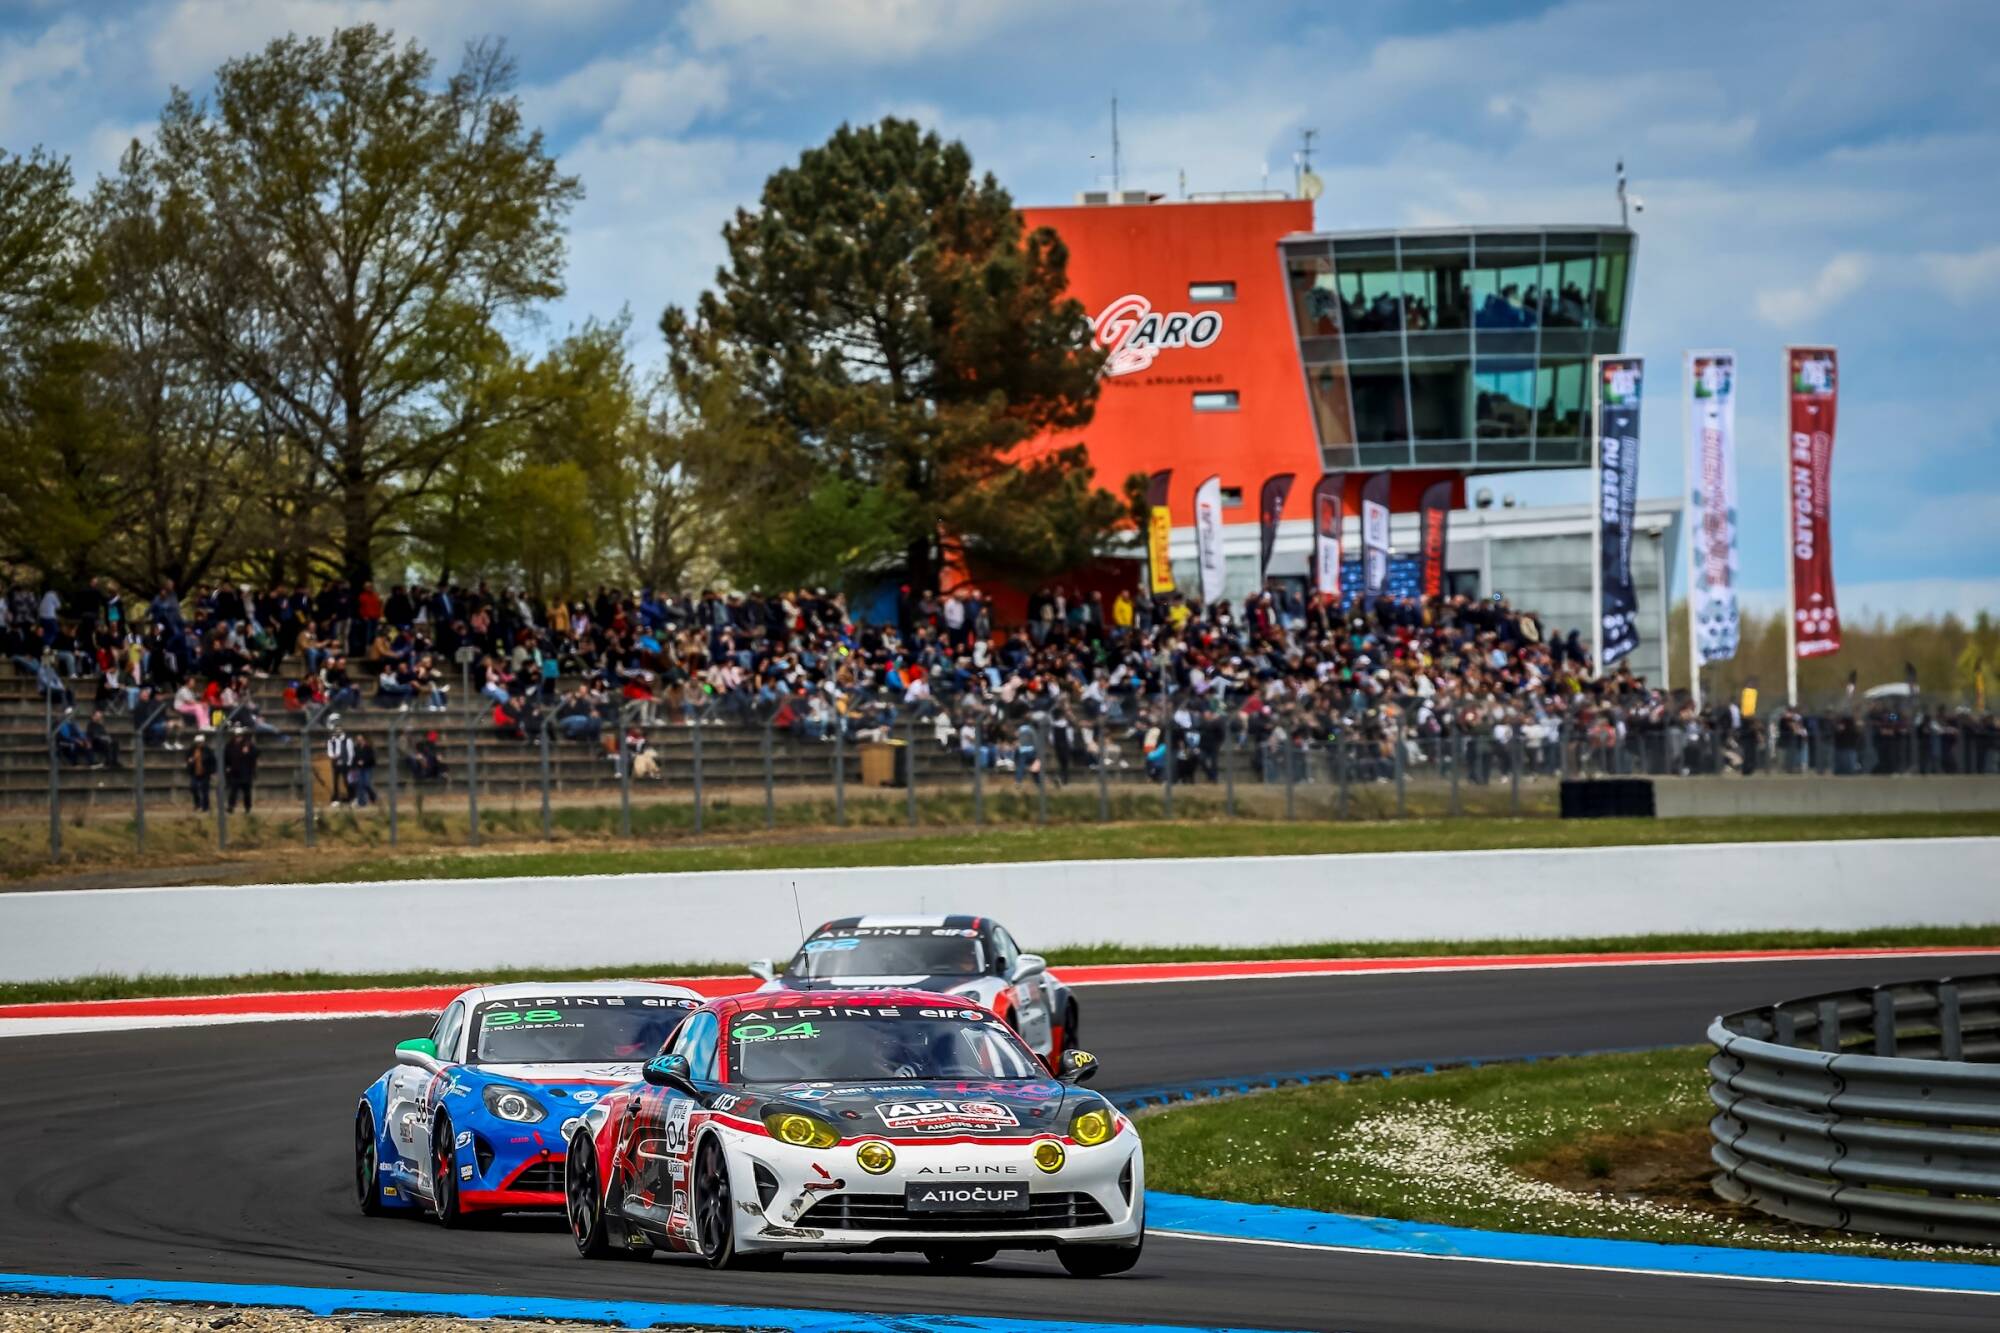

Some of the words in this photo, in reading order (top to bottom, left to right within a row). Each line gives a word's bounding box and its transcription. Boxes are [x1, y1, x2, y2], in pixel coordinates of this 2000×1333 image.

[1602, 436, 1620, 467] DU
[1793, 432, 1811, 463] DE
[1602, 469, 1619, 523] GERS
[1793, 466, 1813, 560] NOGARO
[1425, 508, 1444, 596] WELCOME
[818, 929, 921, 938] ALPINE
[931, 929, 961, 937] elf
[485, 996, 626, 1010] ALPINE
[642, 999, 679, 1007] elf
[485, 1009, 562, 1026] 38
[740, 1006, 902, 1021] ALPINE
[919, 1008, 959, 1018] elf
[732, 1022, 821, 1040] 04
[415, 1097, 427, 1123] 38
[888, 1102, 958, 1117] API
[895, 1118, 919, 1126] Auto
[920, 1116, 948, 1124] Parts
[949, 1115, 1012, 1125] International
[927, 1122, 973, 1131] ANGERS
[667, 1120, 687, 1149] 04
[917, 1165, 1018, 1174] ALPINE
